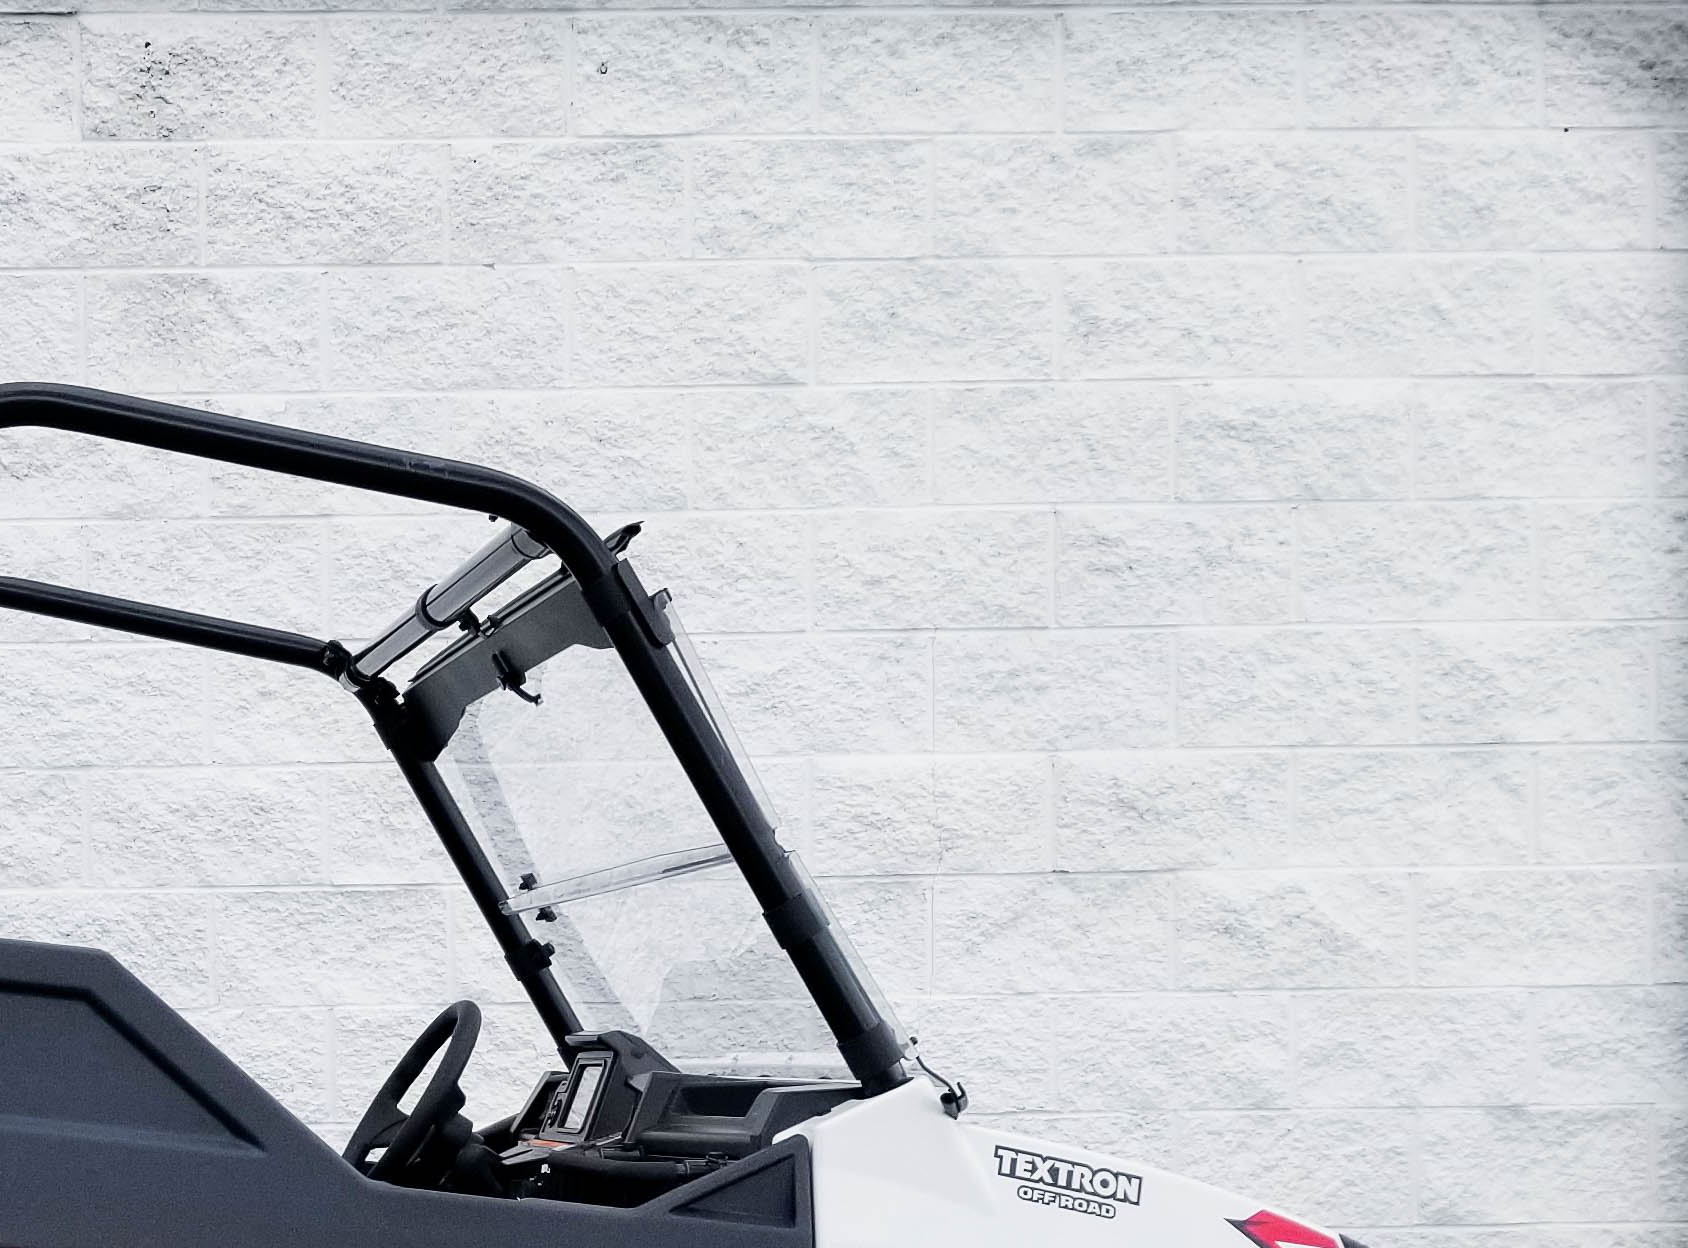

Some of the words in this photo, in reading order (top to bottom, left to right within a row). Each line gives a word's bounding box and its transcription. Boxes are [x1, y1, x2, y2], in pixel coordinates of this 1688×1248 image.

[994, 1145, 1144, 1206] TEXTRON
[1017, 1185, 1057, 1206] OFF
[1058, 1194, 1117, 1219] ROAD
